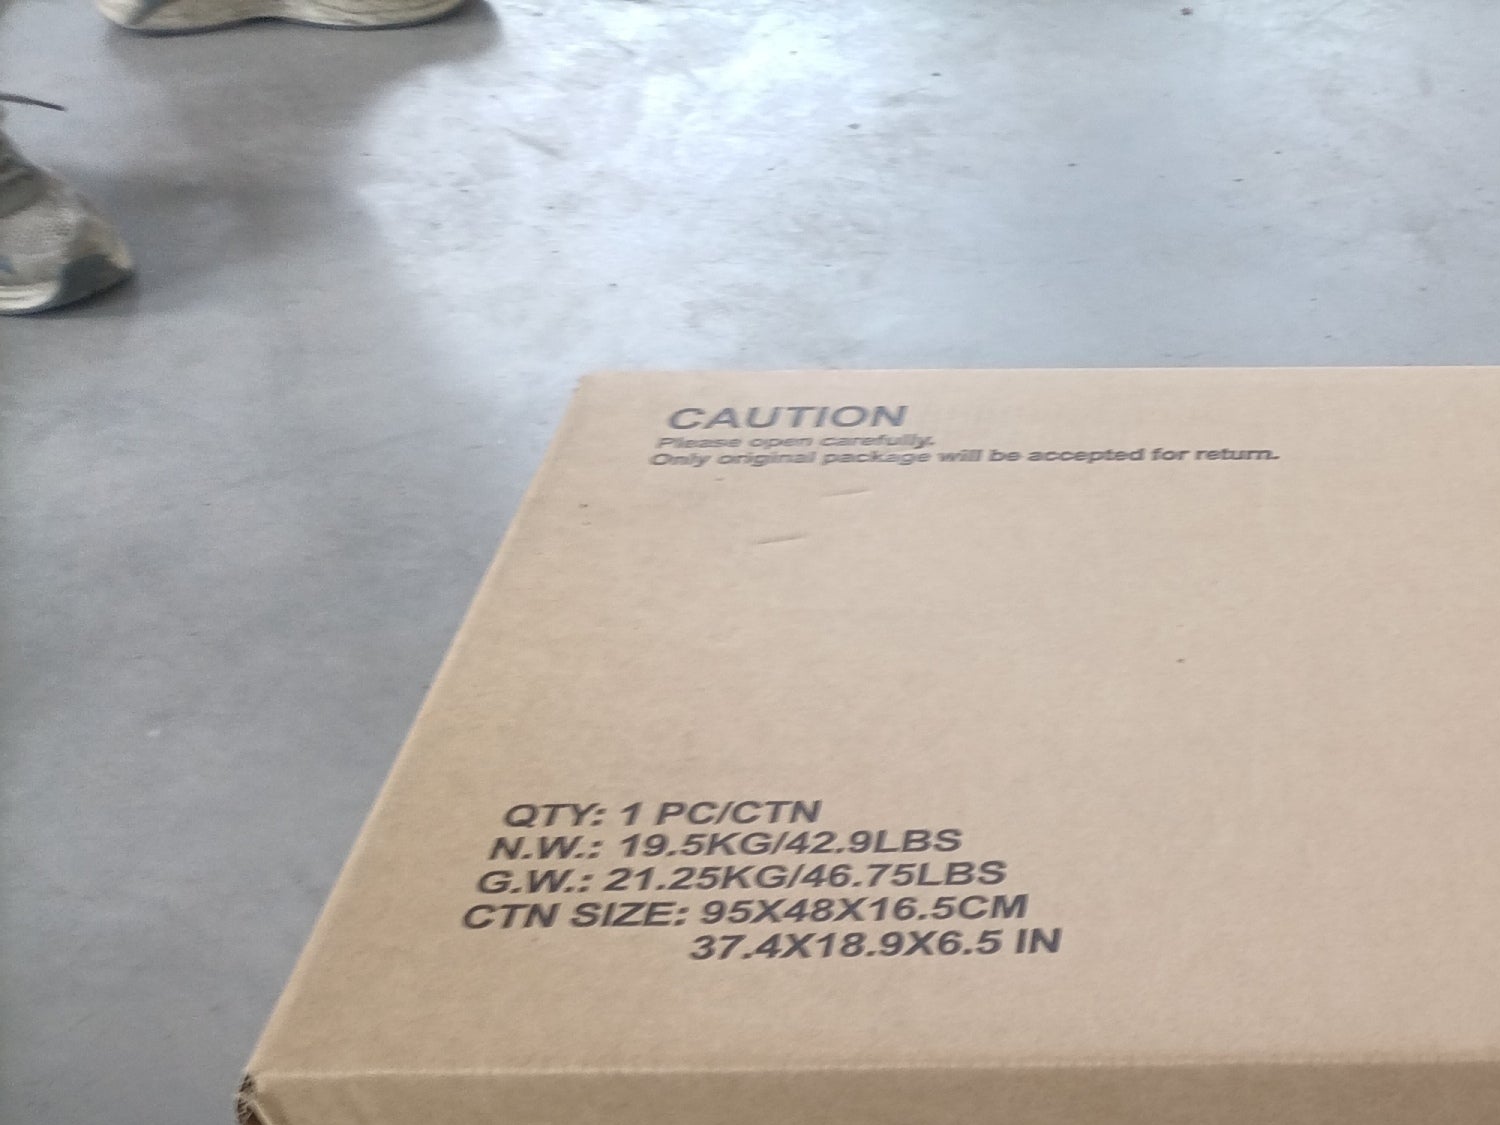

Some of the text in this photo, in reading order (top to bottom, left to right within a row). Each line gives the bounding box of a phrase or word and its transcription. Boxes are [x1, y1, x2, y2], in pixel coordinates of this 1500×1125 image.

[667, 404, 909, 430] CAUTION
[650, 445, 1281, 467] Only original package will be accepted for return.
[656, 432, 935, 451] Please open carefully.
[504, 799, 822, 829] QTY: 1 PC/CTN
[487, 828, 963, 861] N.W.: 19.5KG/42.9LBS
[476, 860, 1008, 895] G.W.: 21.25KG/46.75LBS
[464, 894, 1029, 931] CTN SIZE: 95X48X16.5CM
[688, 927, 1063, 961] 37.4X18.9X6.5 IN
